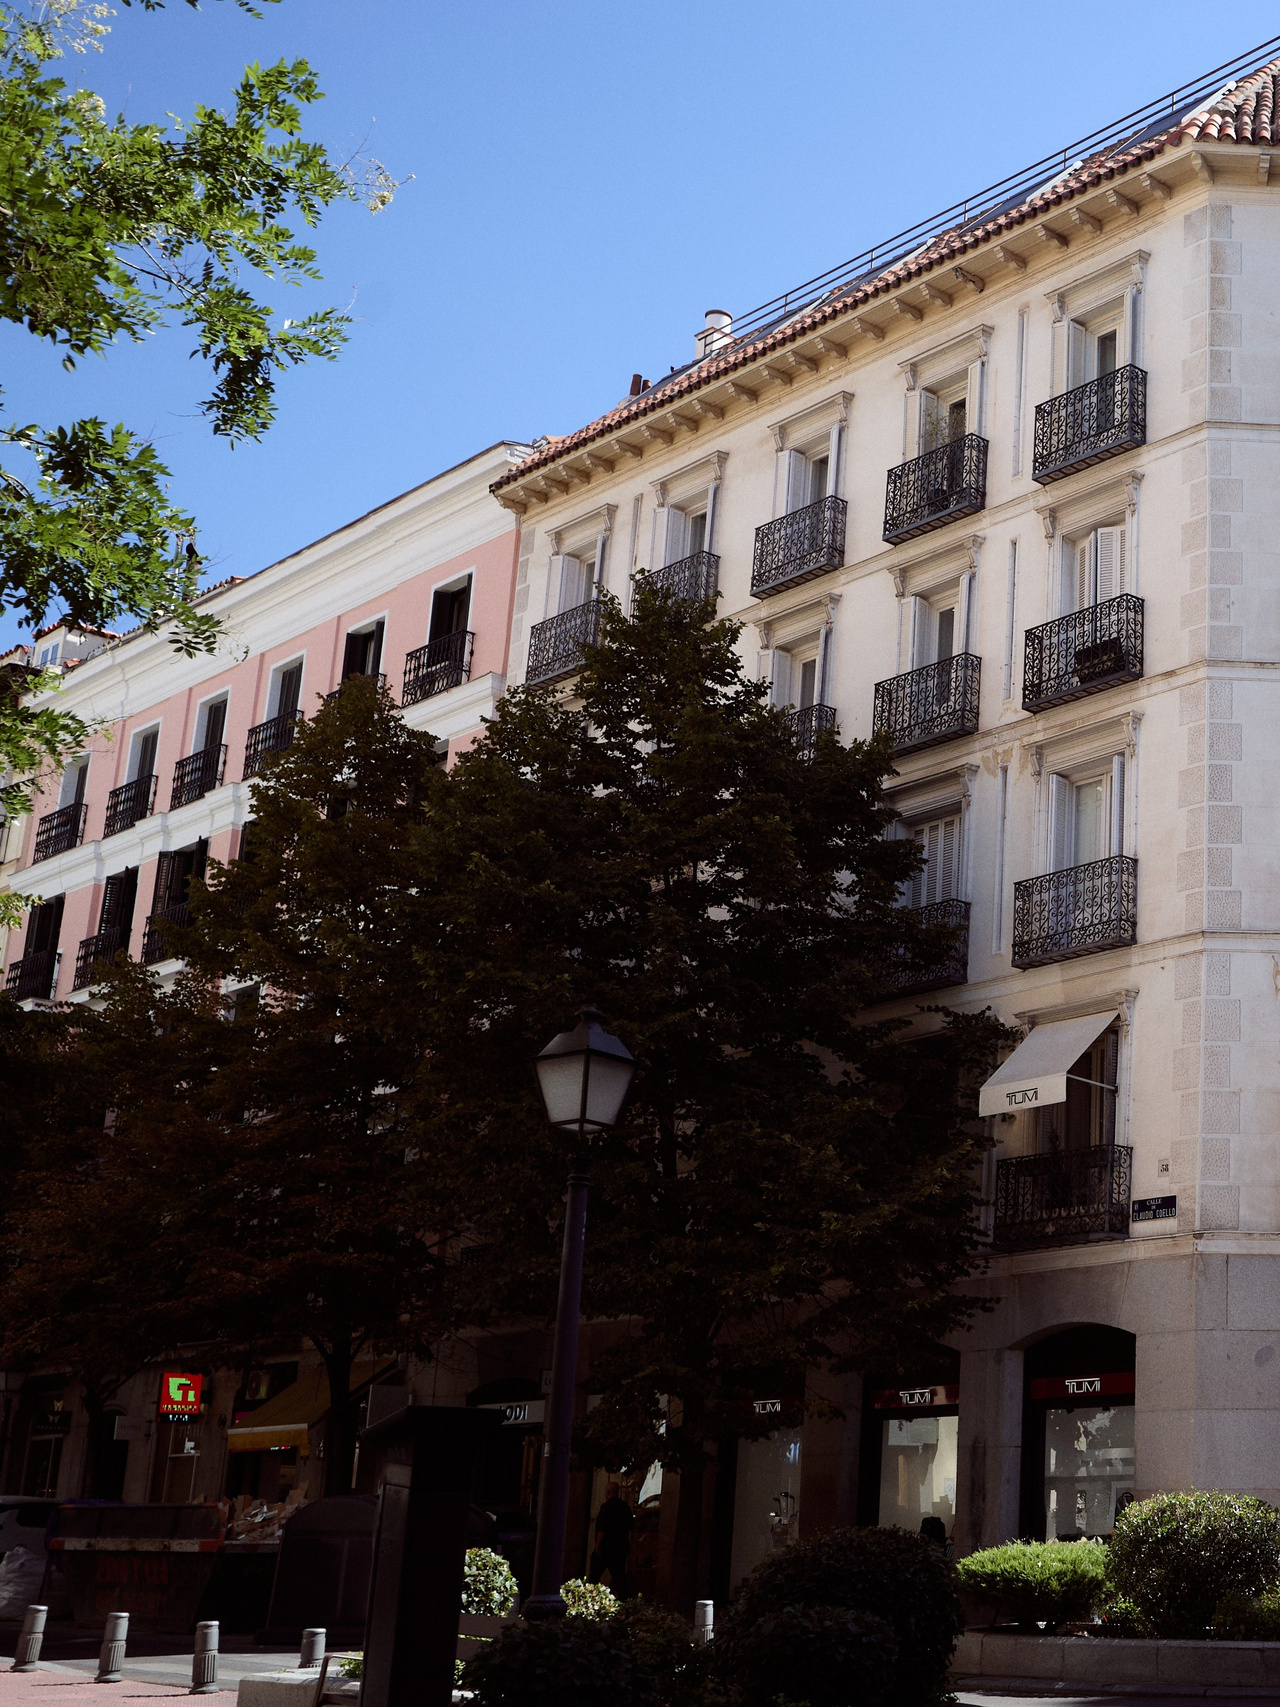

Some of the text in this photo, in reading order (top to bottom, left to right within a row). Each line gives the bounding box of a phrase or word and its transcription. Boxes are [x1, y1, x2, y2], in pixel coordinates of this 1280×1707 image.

[1006, 1087, 1038, 1107] TUMI
[1160, 1163, 1169, 1173] 58
[1146, 1198, 1162, 1206] CALLE
[1133, 1207, 1176, 1221] CLAUDIO COELLO
[1065, 1377, 1100, 1394] TUMI
[898, 1389, 931, 1405] TUMI
[753, 1399, 781, 1414] TUMI
